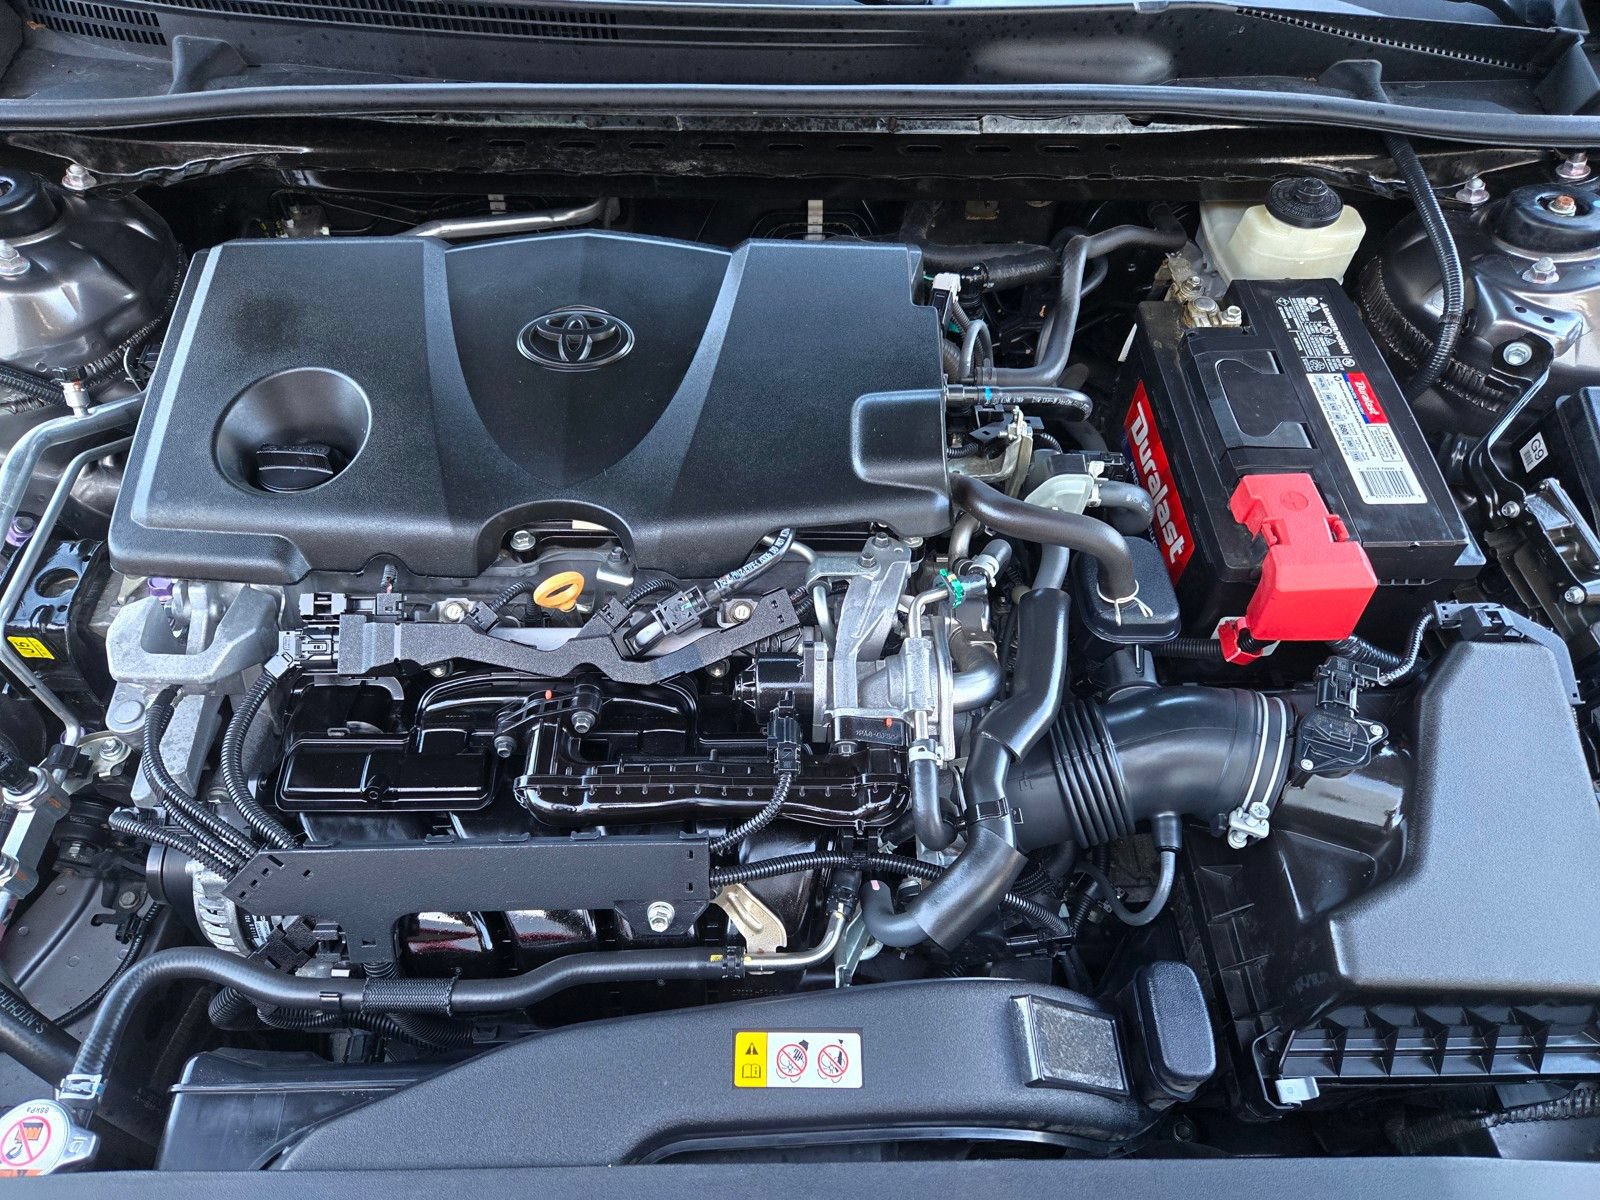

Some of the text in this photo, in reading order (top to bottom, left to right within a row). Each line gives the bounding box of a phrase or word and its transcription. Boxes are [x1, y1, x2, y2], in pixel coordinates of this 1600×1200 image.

[1354, 380, 1380, 415] Duralast
[1531, 438, 1545, 461] G9
[1131, 401, 1185, 564] Duralast
